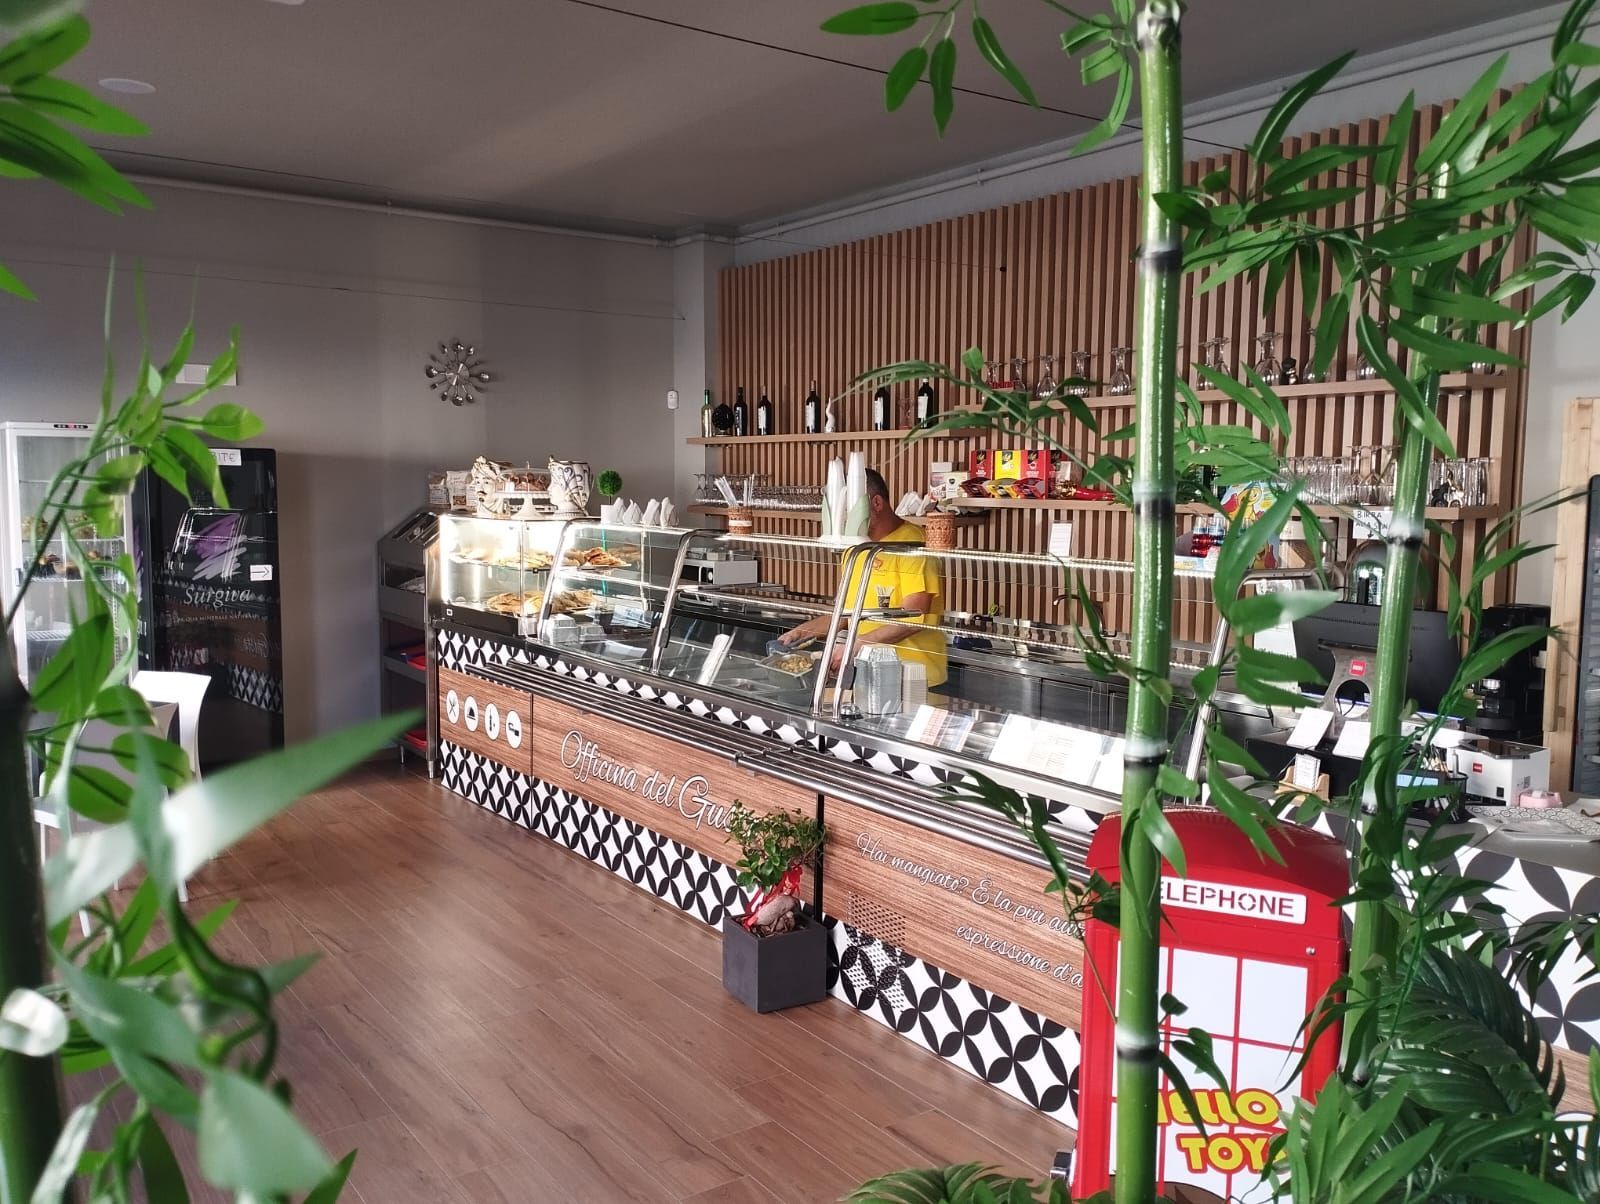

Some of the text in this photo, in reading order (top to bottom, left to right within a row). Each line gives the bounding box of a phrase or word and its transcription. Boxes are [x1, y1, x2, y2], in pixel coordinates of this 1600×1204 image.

[184, 586, 252, 608] Surgiva
[561, 730, 740, 832] Officina del Gus
[856, 832, 889, 863] Hai
[891, 854, 970, 894] mangiato?
[993, 890, 1013, 912] la
[1161, 881, 1295, 918] LEPHONE
[956, 925, 1051, 974] espressione
[1176, 1133, 1286, 1174] TOY
